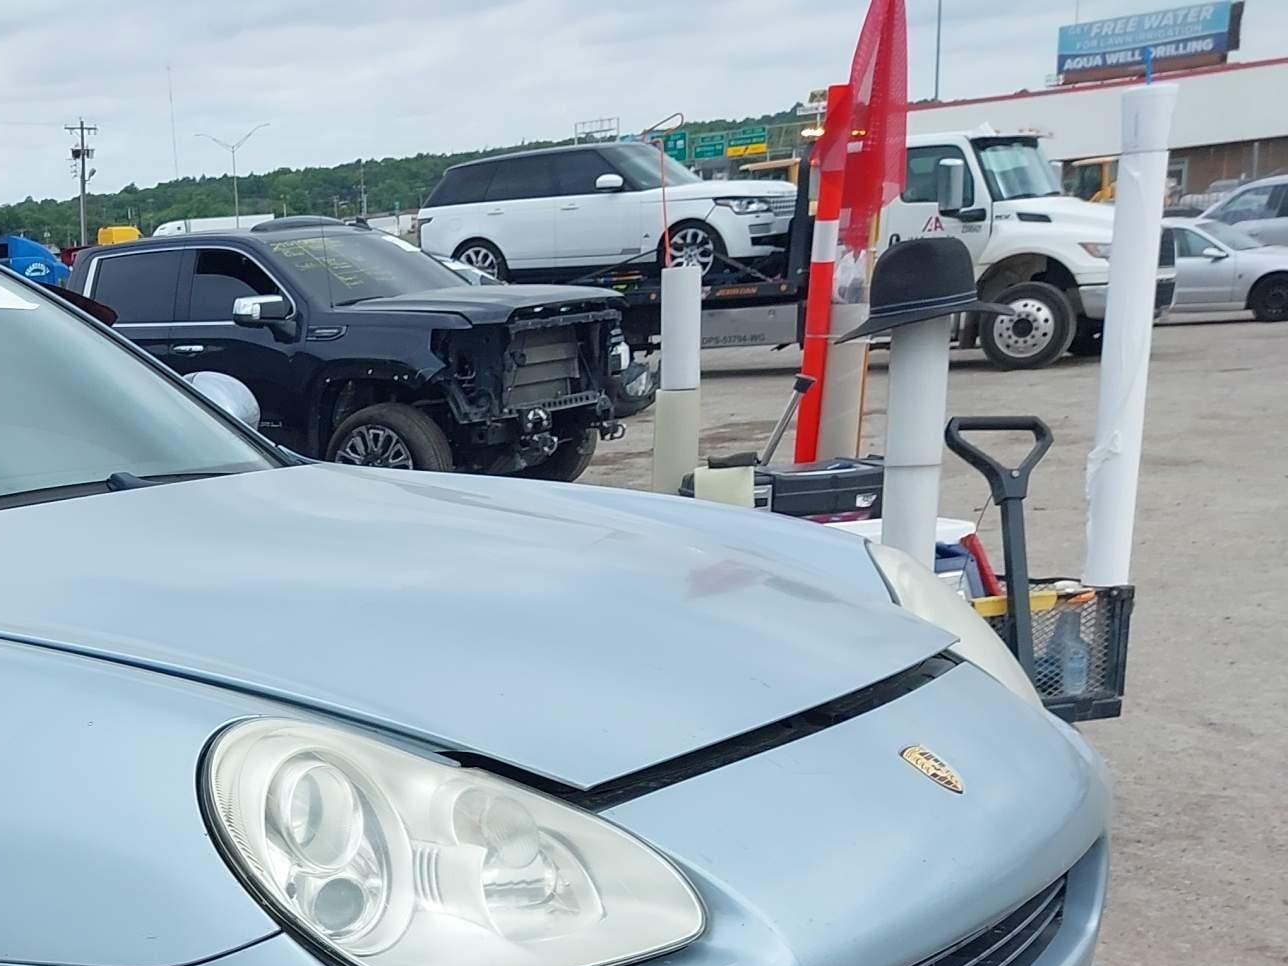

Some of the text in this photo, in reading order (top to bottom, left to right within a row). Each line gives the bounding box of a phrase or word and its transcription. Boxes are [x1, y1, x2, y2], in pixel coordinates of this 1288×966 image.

[1090, 15, 1137, 37] FREE
[1143, 5, 1214, 30] WATER
[1076, 38, 1098, 50] FOR
[1099, 34, 1132, 48] LAWN
[1063, 54, 1103, 71] AQUA
[1105, 51, 1142, 66] WELL
